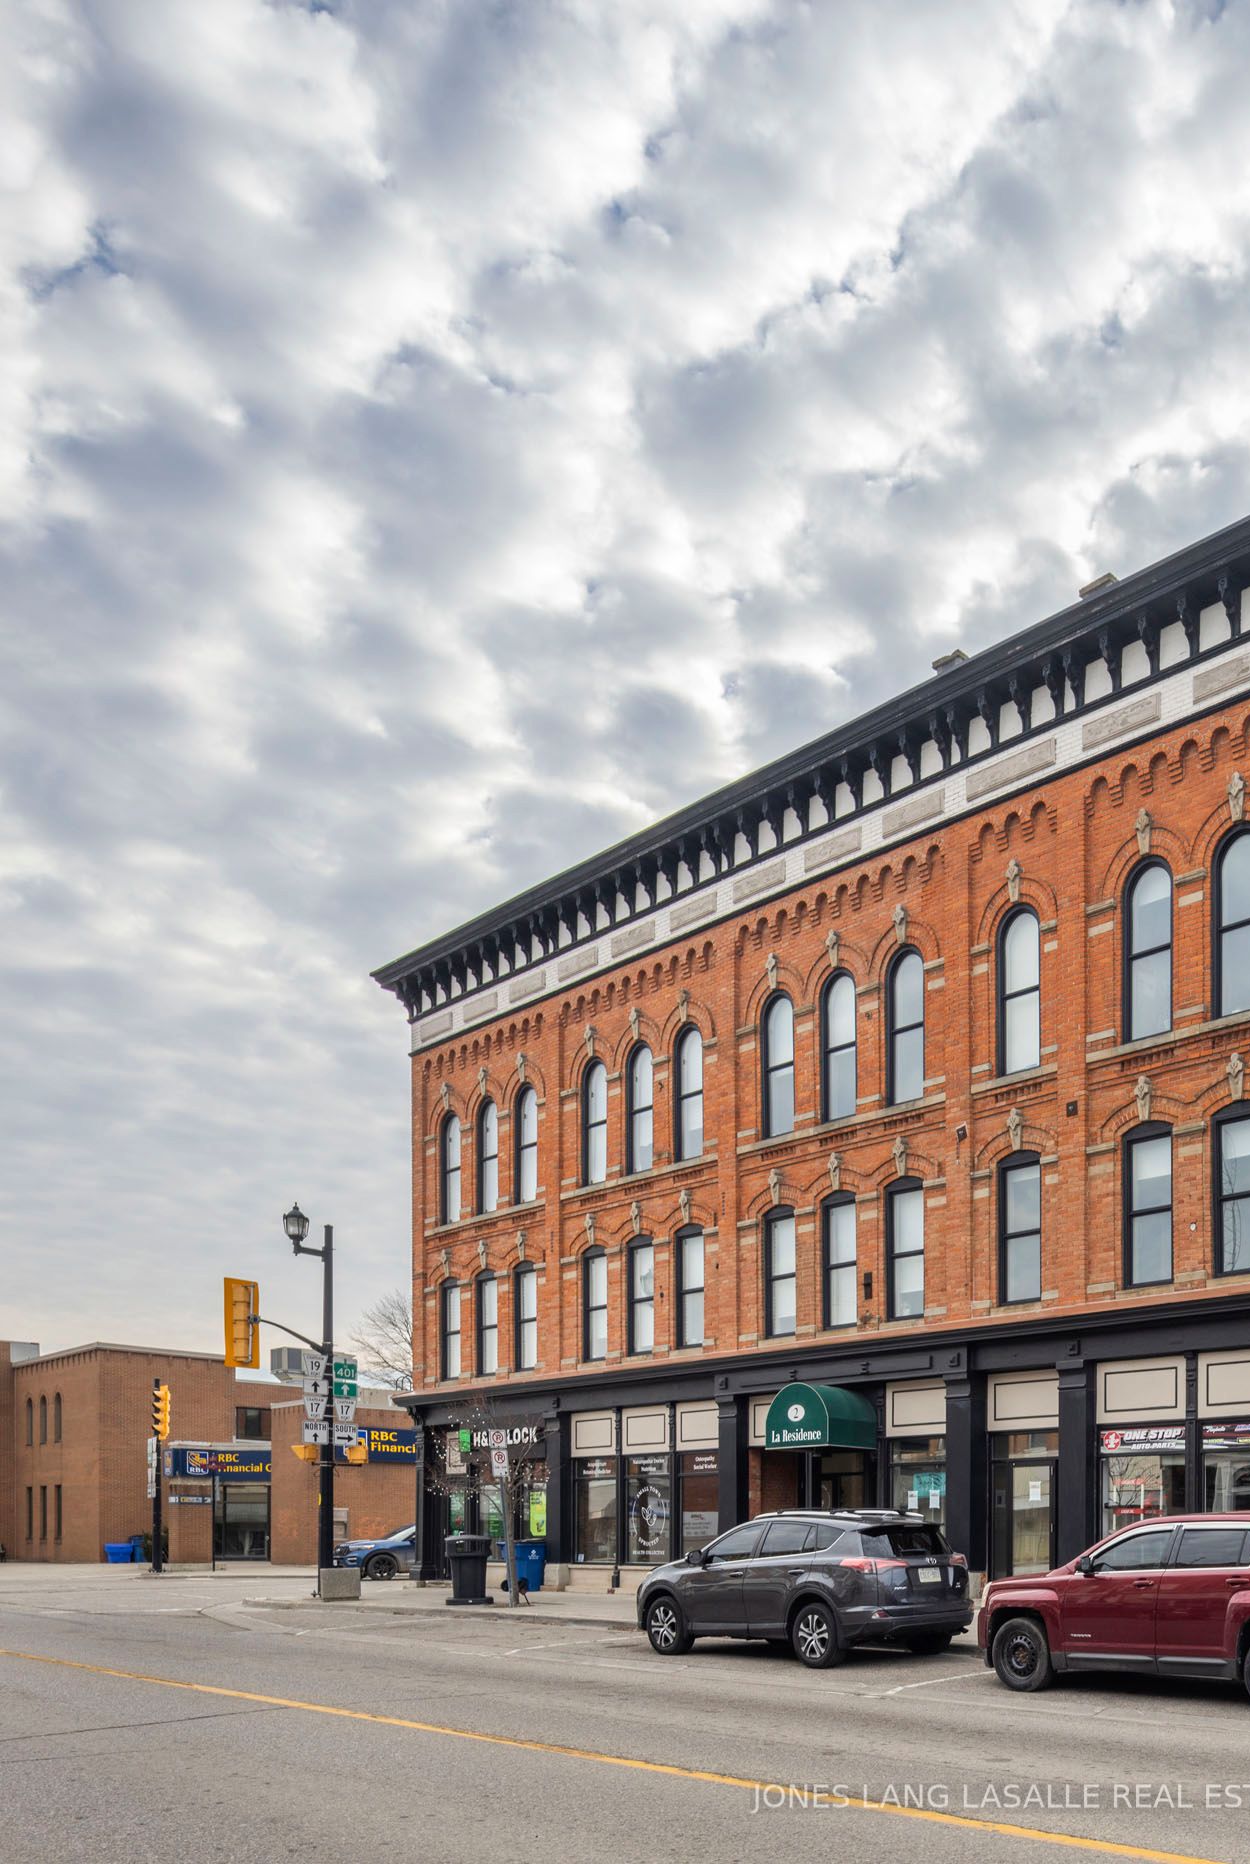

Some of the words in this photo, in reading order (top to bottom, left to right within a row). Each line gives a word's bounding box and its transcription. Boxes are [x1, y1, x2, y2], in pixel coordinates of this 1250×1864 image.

[310, 1361, 320, 1371] 19
[337, 1369, 355, 1378] 401
[310, 1402, 320, 1413] 17
[340, 1405, 350, 1415] 17
[793, 1407, 799, 1419] 2
[304, 1422, 327, 1430] NORTH
[335, 1425, 356, 1433] SOUTH
[370, 1431, 398, 1441] RBC
[473, 1430, 491, 1448] H&
[507, 1426, 538, 1445] LOCK
[771, 1430, 781, 1443] La
[782, 1428, 822, 1442] Residence
[1124, 1429, 1148, 1441] ONE
[1149, 1427, 1182, 1440] STOP
[217, 1453, 239, 1463] RBC
[217, 1462, 263, 1473] nancial
